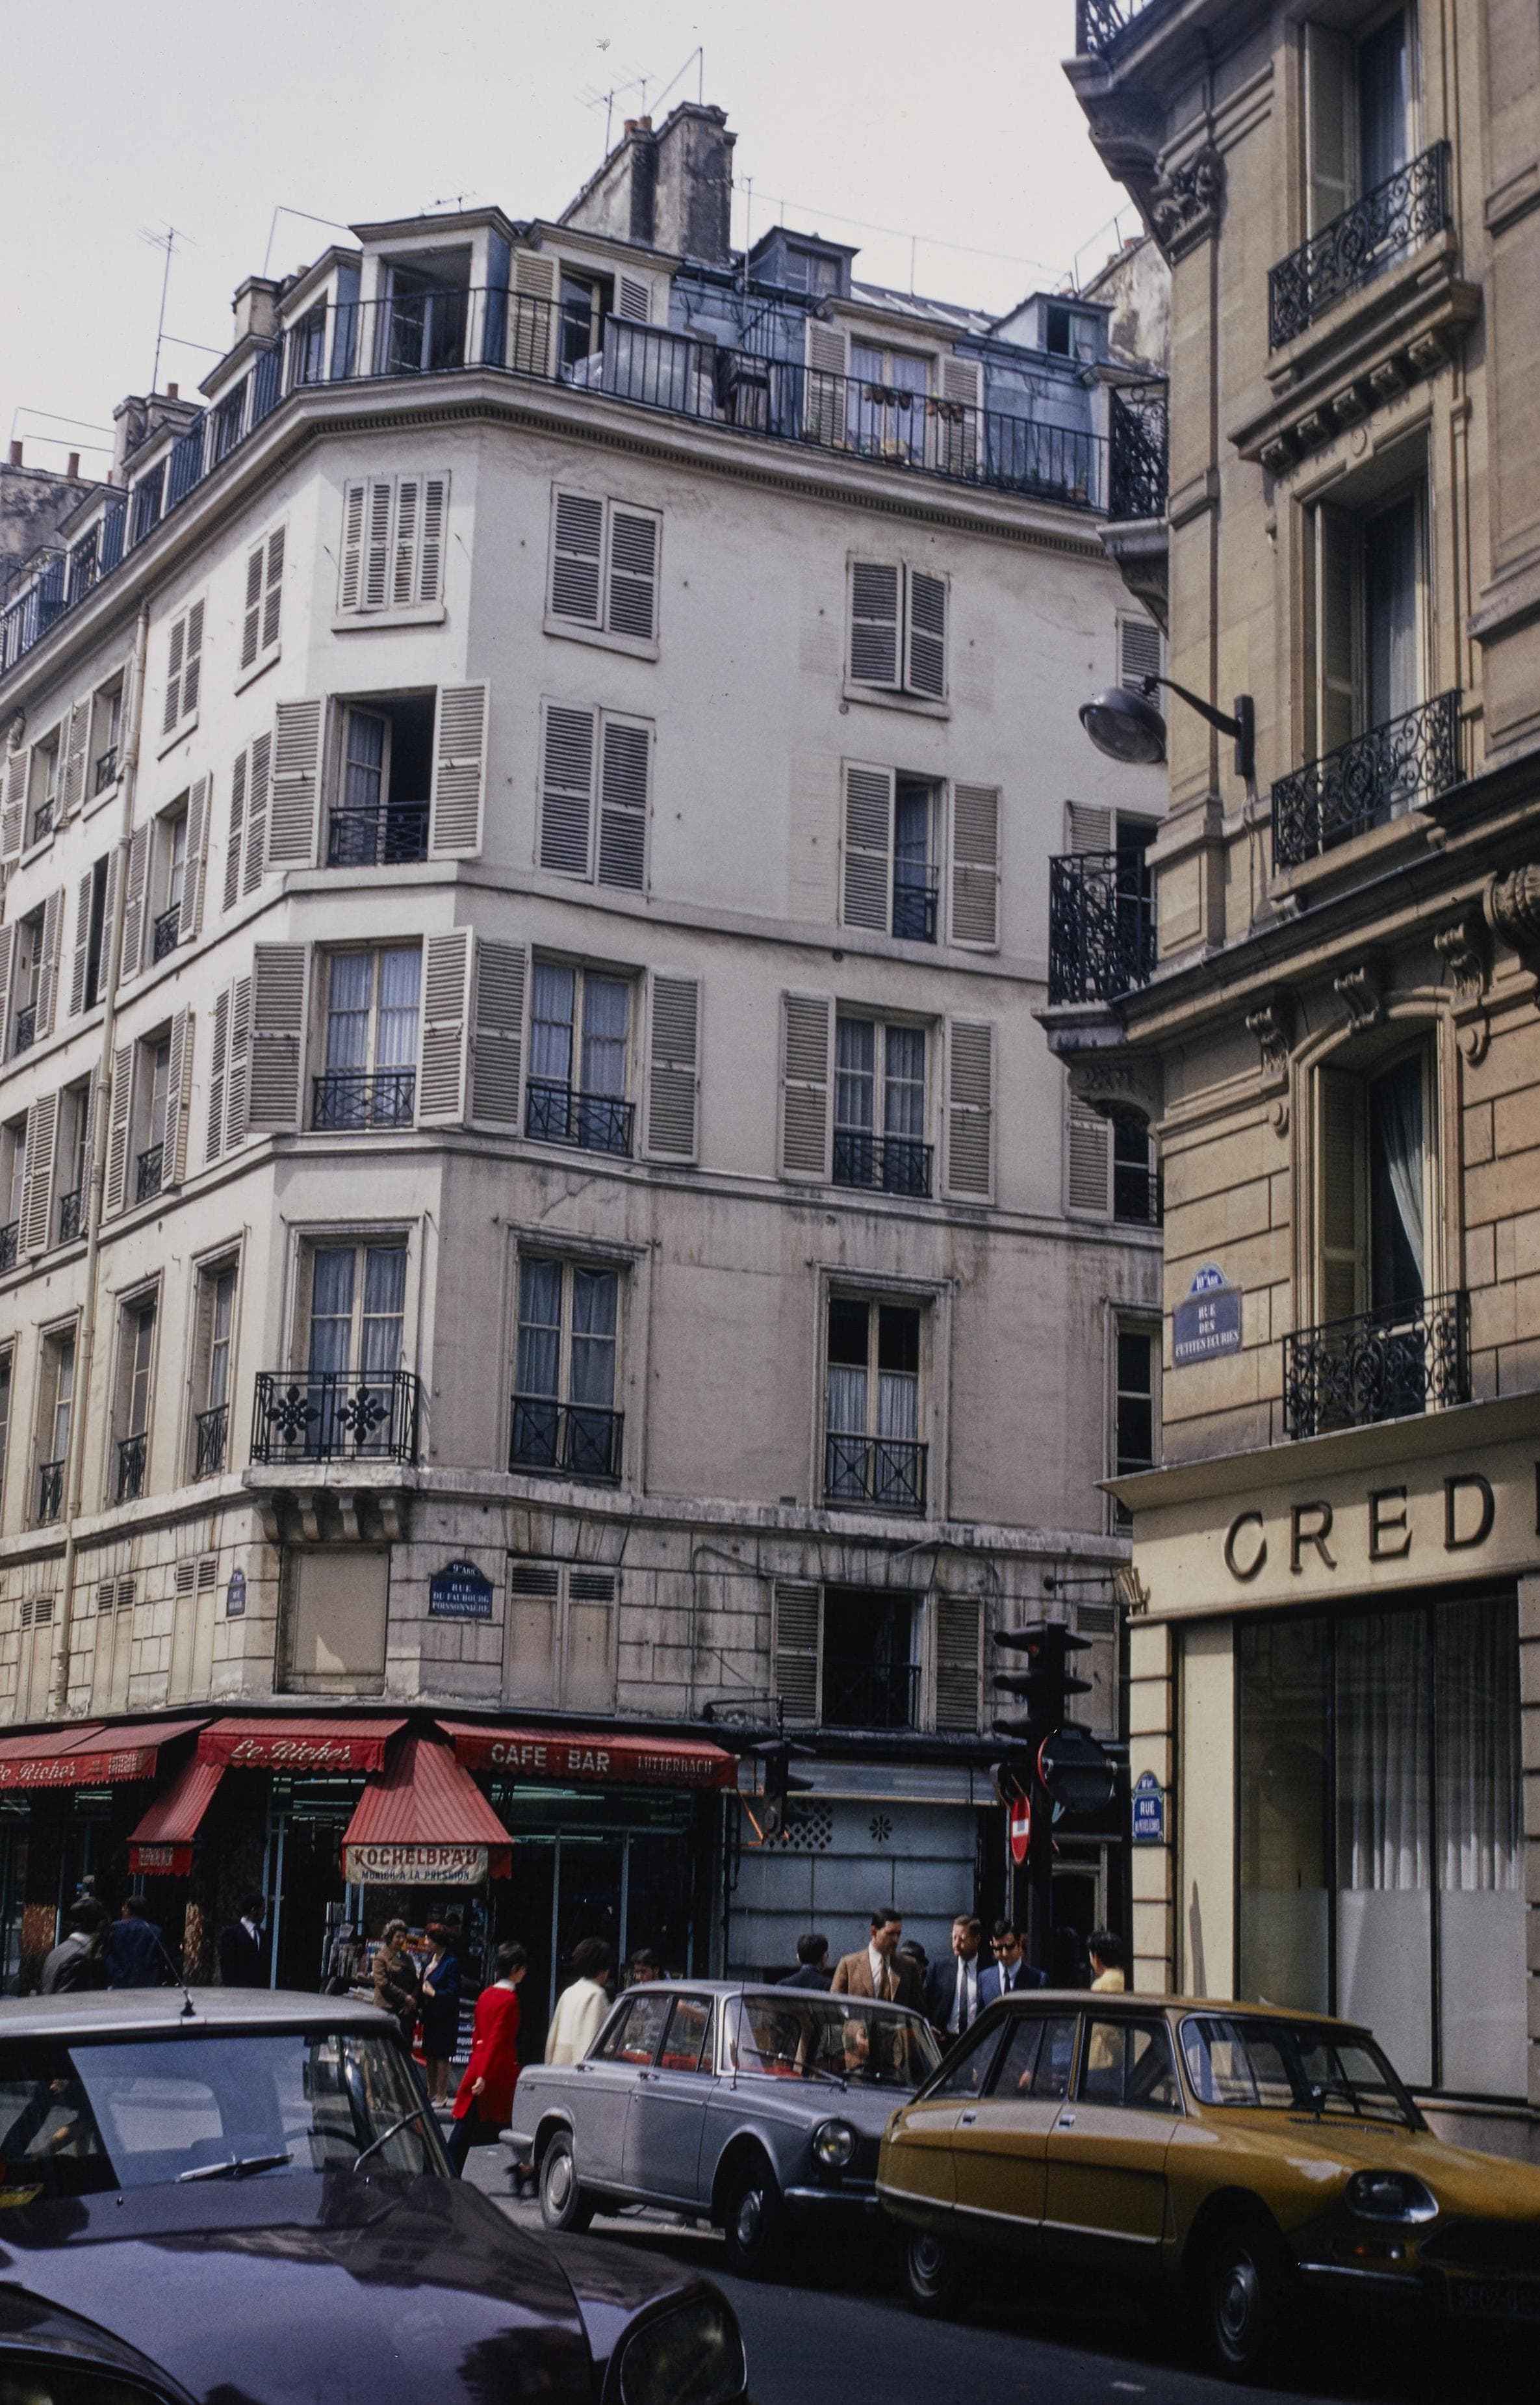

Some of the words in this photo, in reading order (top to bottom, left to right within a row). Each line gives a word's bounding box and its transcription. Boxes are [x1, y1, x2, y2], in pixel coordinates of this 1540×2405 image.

[1198, 1303, 1216, 1320] RUE
[1199, 1319, 1216, 1335] DES
[1175, 1336, 1206, 1357] PETITES
[452, 1583, 472, 1592] RUE
[433, 1591, 444, 1600] DU
[446, 1592, 489, 1604] FAUBOURG
[230, 1739, 264, 1760] Le
[265, 1740, 352, 1762] Richer
[491, 1743, 548, 1768] CAFE
[567, 1749, 610, 1773] BAR
[16, 1758, 77, 1782] Richer
[637, 1755, 712, 1774] LUTTERBACH
[1140, 1800, 1155, 1817] RUE
[409, 1871, 420, 1880] LA
